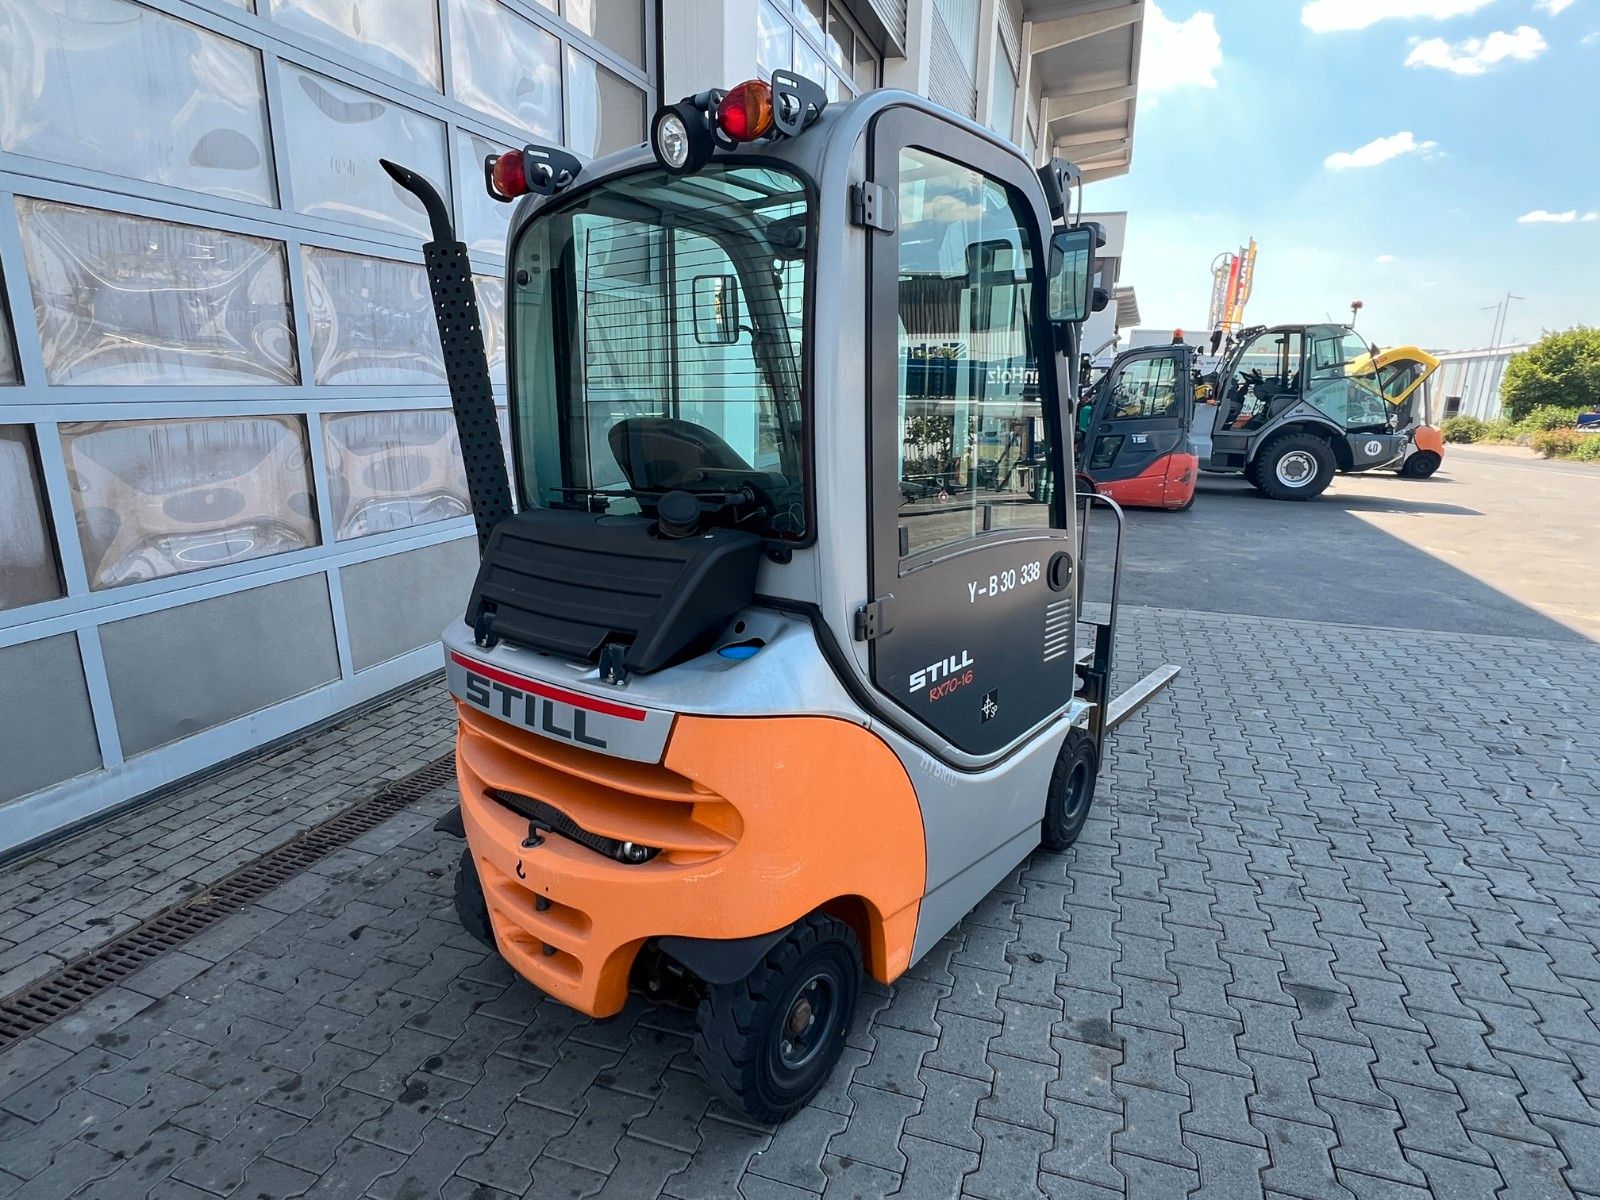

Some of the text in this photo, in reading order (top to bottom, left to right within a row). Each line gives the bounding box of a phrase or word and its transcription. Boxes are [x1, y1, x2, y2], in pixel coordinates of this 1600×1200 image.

[1367, 442, 1379, 453] 40
[1020, 561, 1041, 585] 338
[909, 650, 974, 694] STILL
[929, 669, 974, 703] RX70-16
[466, 671, 607, 750] STILL
